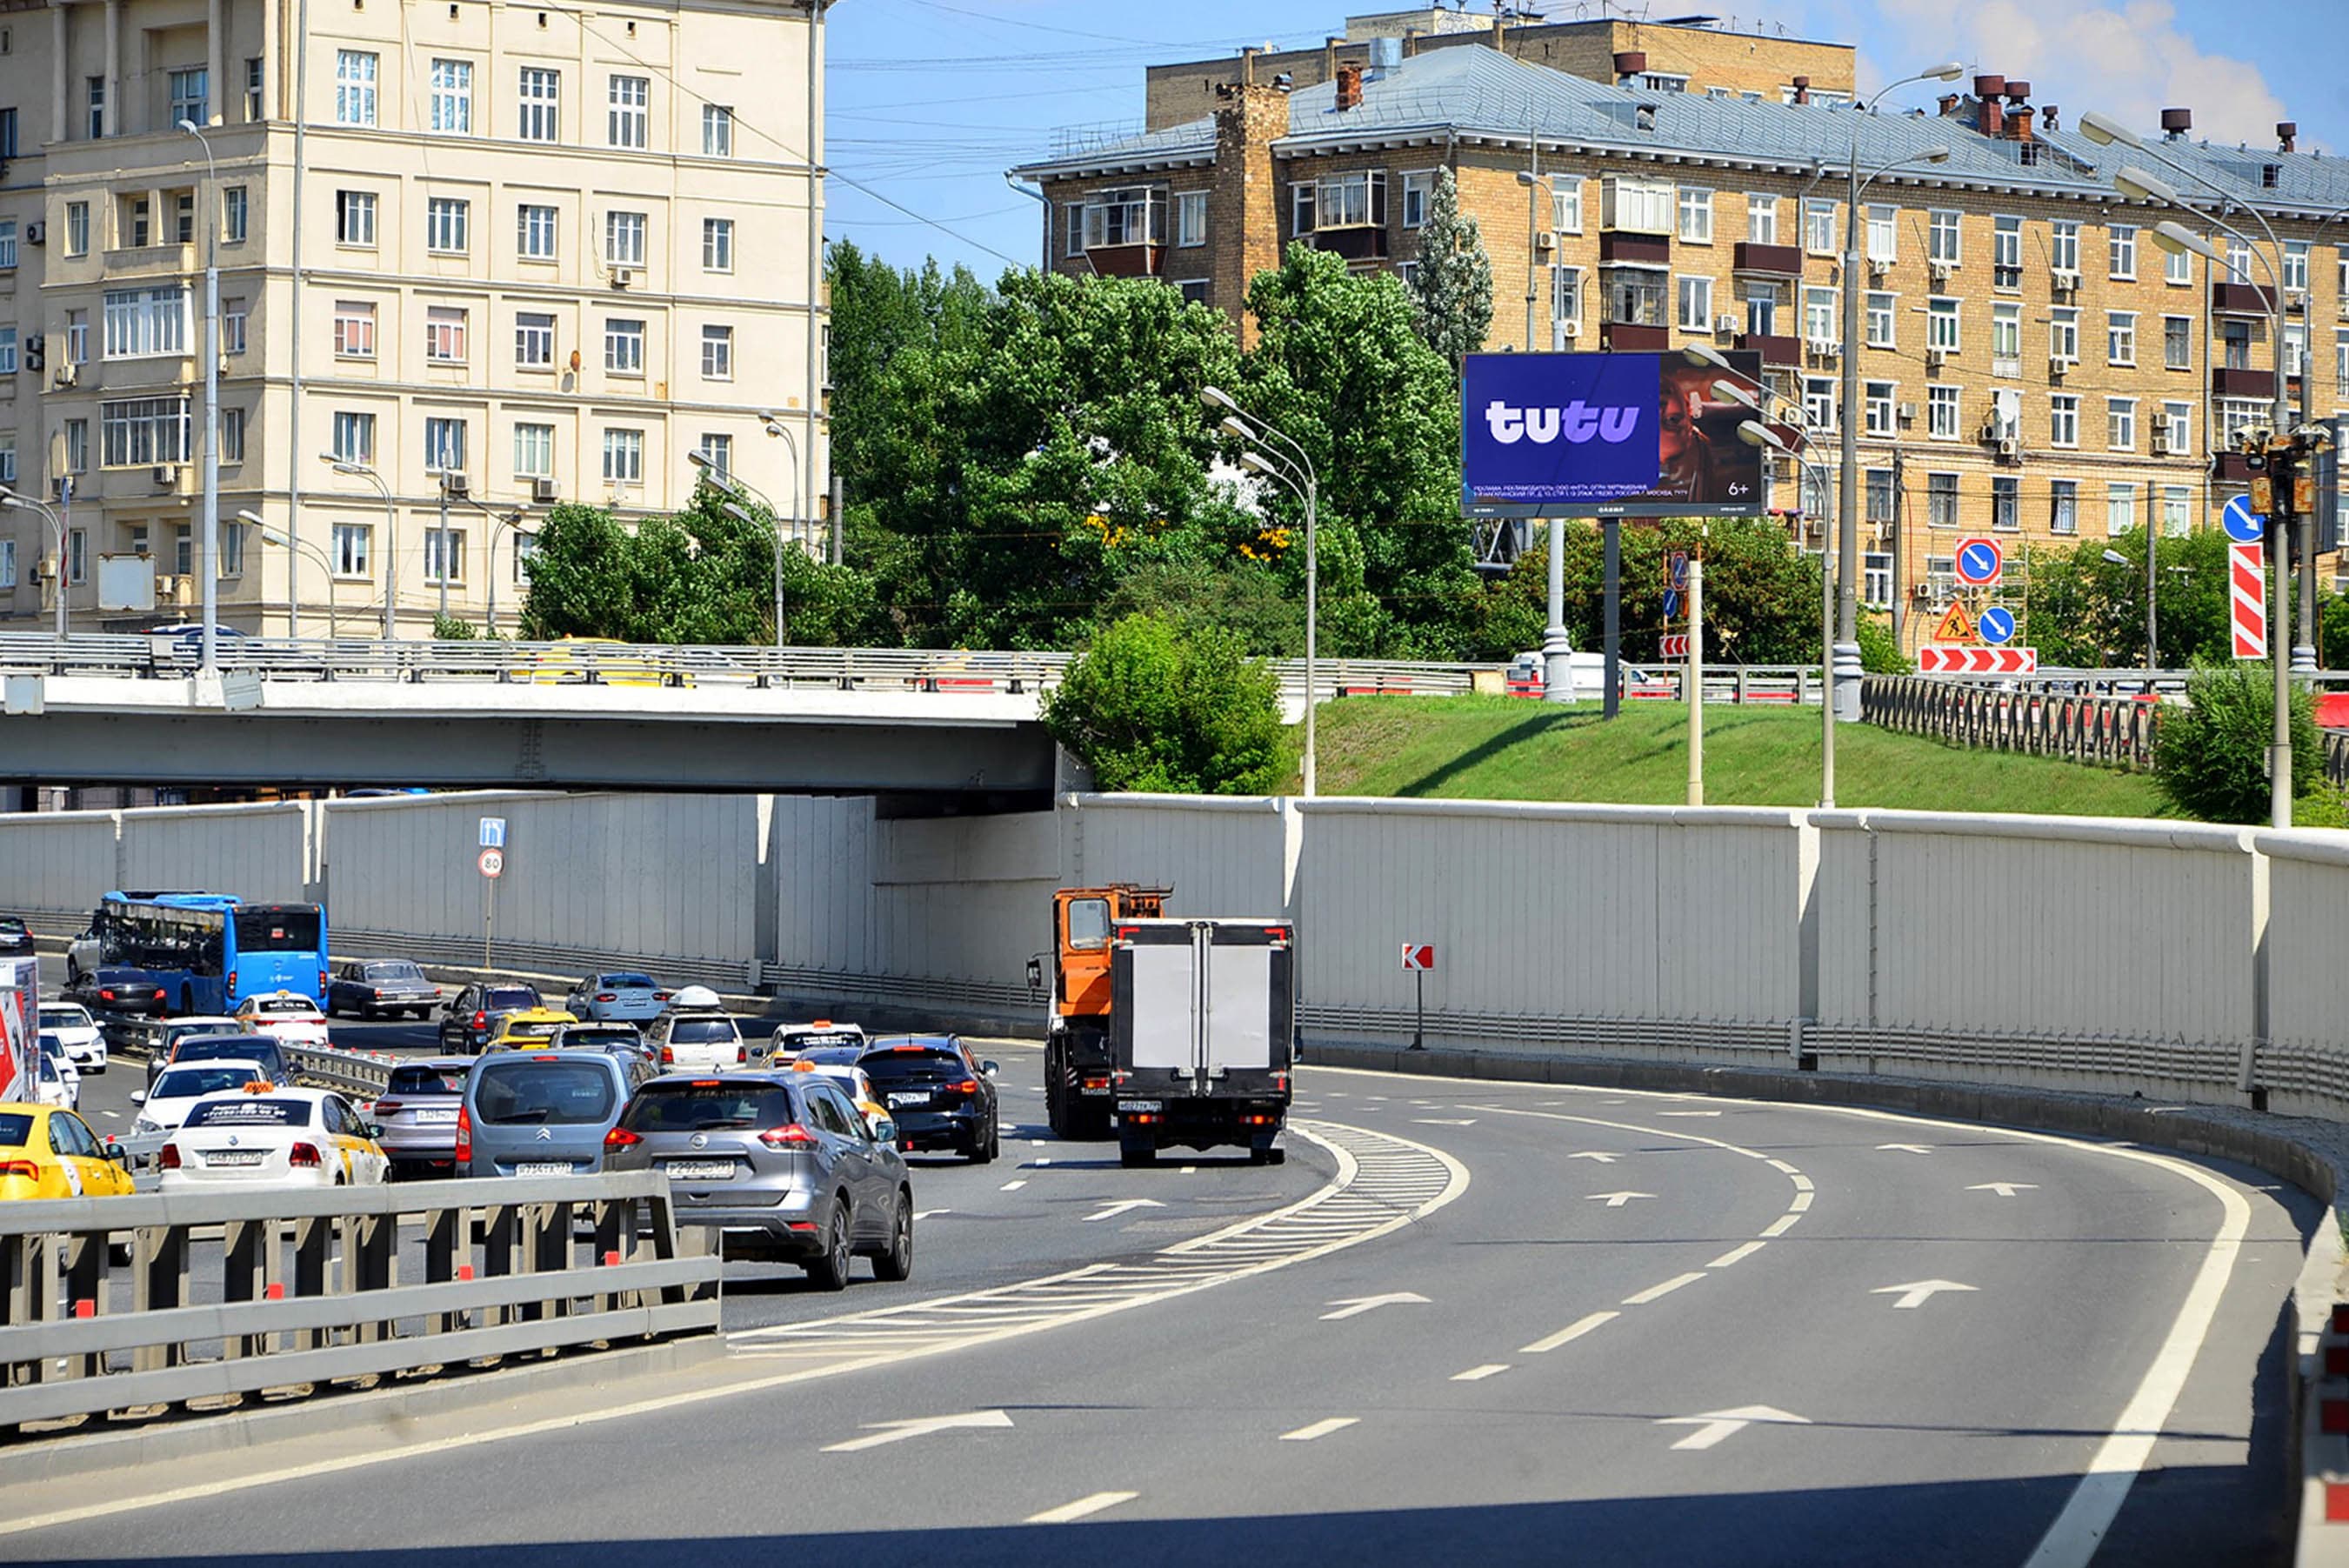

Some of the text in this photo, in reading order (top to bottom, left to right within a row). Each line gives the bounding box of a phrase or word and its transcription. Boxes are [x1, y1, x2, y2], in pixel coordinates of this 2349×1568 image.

[1485, 400, 1640, 444] tutu
[1728, 482, 1749, 496] 6+
[484, 857, 500, 869] 80
